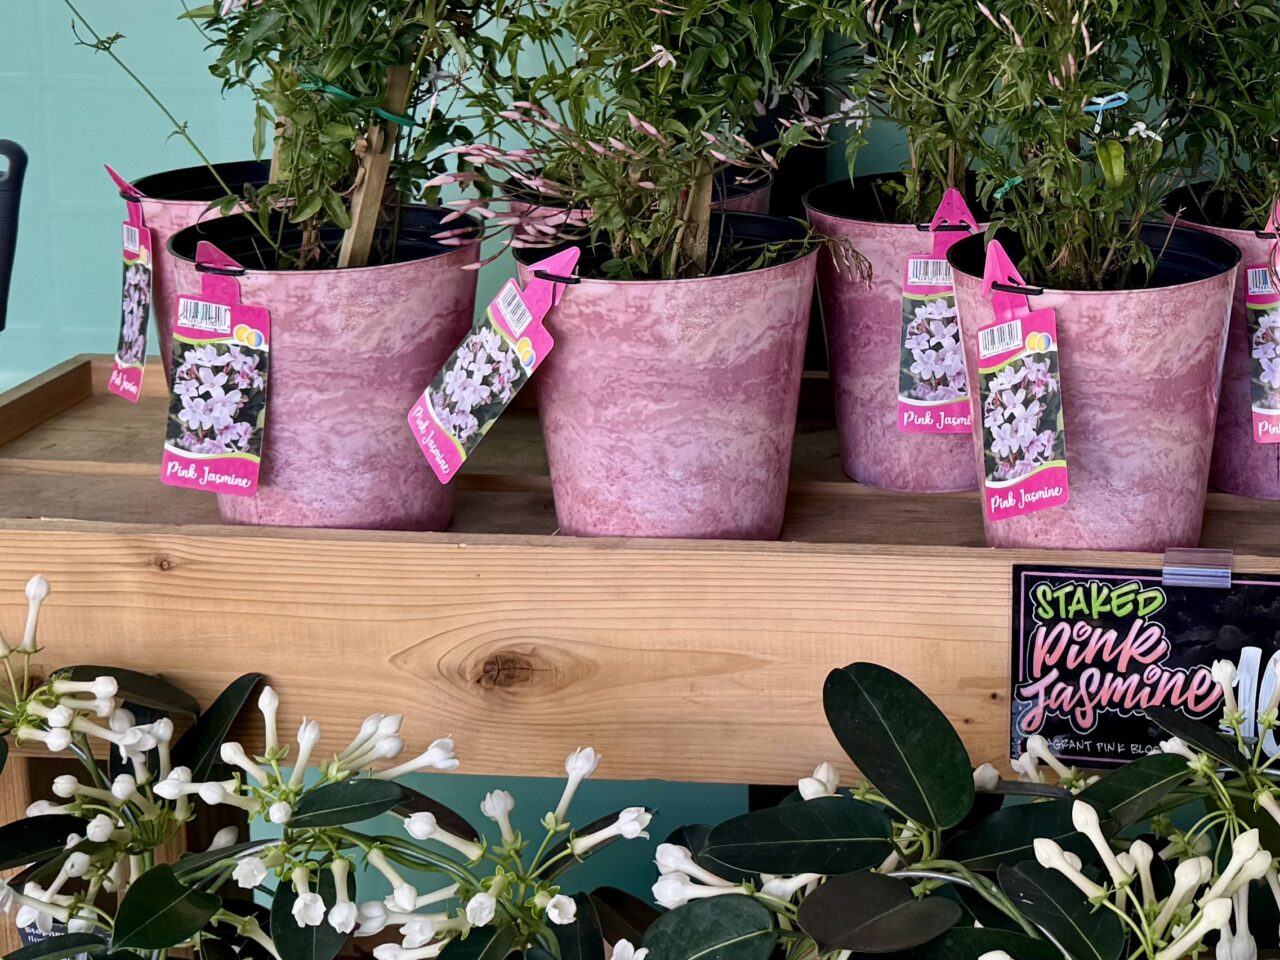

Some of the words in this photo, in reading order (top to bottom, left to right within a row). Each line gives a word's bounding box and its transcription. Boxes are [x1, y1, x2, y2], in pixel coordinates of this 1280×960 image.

[903, 410, 934, 427] Pink
[936, 411, 972, 430] Jasmi
[412, 405, 431, 434] Pink
[422, 430, 450, 474] Jasmine
[166, 460, 198, 479] Pink
[199, 466, 252, 488] Jasmine
[990, 491, 1017, 514] Pink
[1018, 486, 1063, 510] Jasmine
[1035, 581, 1165, 620] STAKED
[1019, 663, 1223, 732] Jasmine
[1096, 741, 1126, 753] PINK
